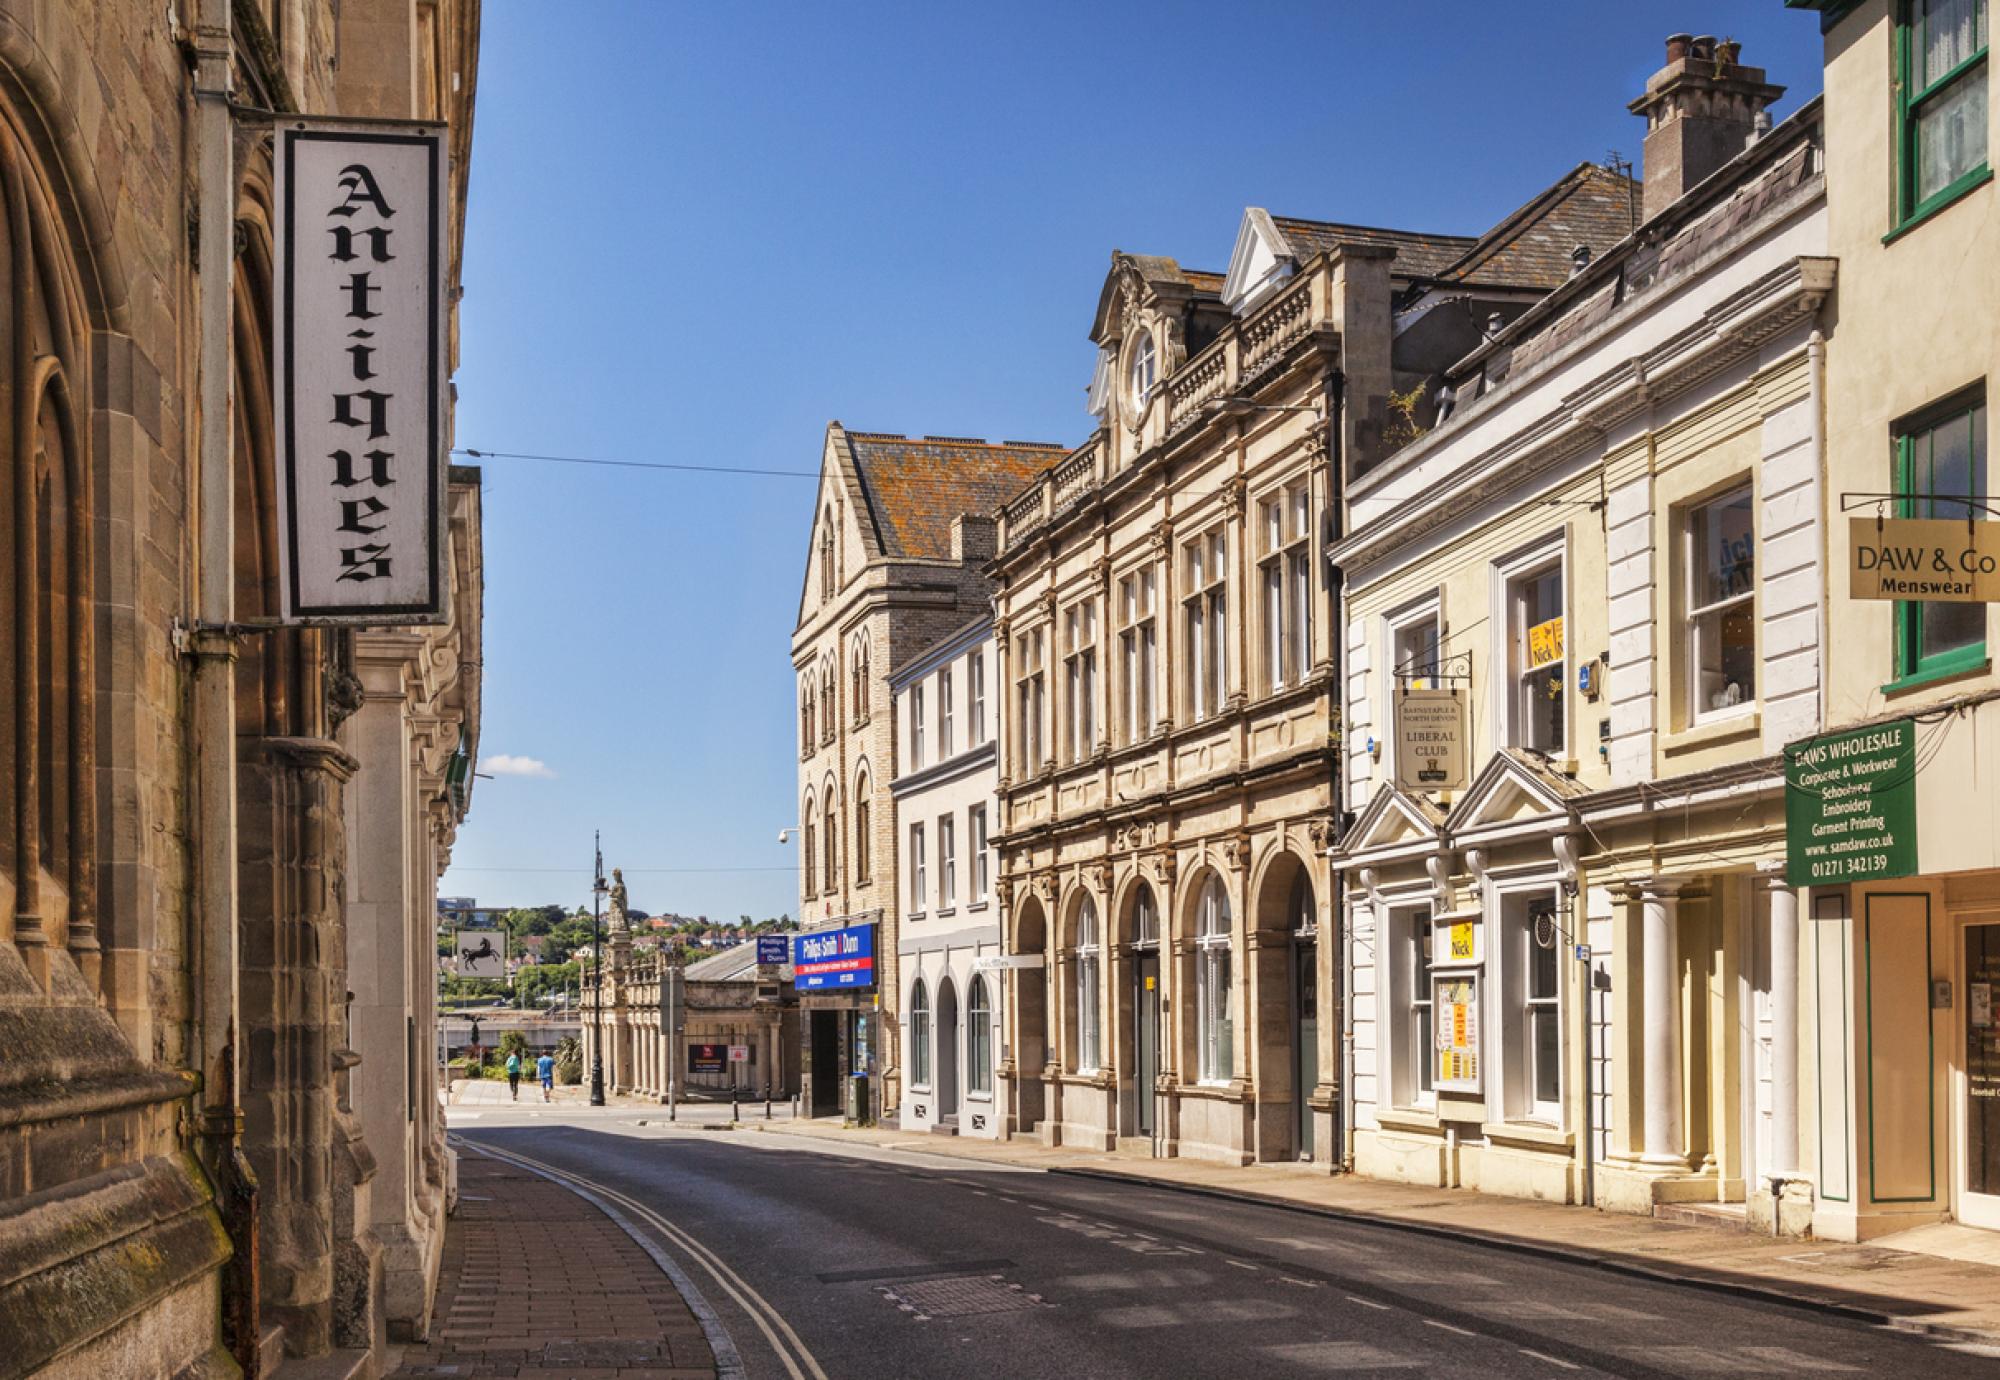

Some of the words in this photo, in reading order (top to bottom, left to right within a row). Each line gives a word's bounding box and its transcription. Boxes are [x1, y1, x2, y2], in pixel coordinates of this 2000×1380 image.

[327, 164, 396, 583] Antiques
[1858, 546, 1923, 571] DAW
[1932, 548, 1955, 572] &
[1960, 549, 1996, 573] Co
[1881, 578, 1972, 594] Menswear
[1533, 643, 1554, 666] Nick
[1406, 732, 1456, 742] LIBERAL
[1830, 729, 1901, 760] WHOLESALE
[1415, 745, 1448, 756] CLUB
[1800, 767, 1840, 786] Corporate
[1843, 765, 1850, 777] &
[1852, 757, 1897, 776] Workwear
[1822, 781, 1872, 800] Schoolwear
[1822, 798, 1872, 817] Embroidery
[1812, 821, 1848, 836] Garment
[1850, 816, 1885, 832] Printing
[1830, 832, 1894, 854] samdaw.co.uk
[1812, 860, 1842, 877] 01271
[1847, 855, 1887, 873] 342139
[843, 932, 858, 953] Dunn
[1452, 939, 1470, 956] Nick
